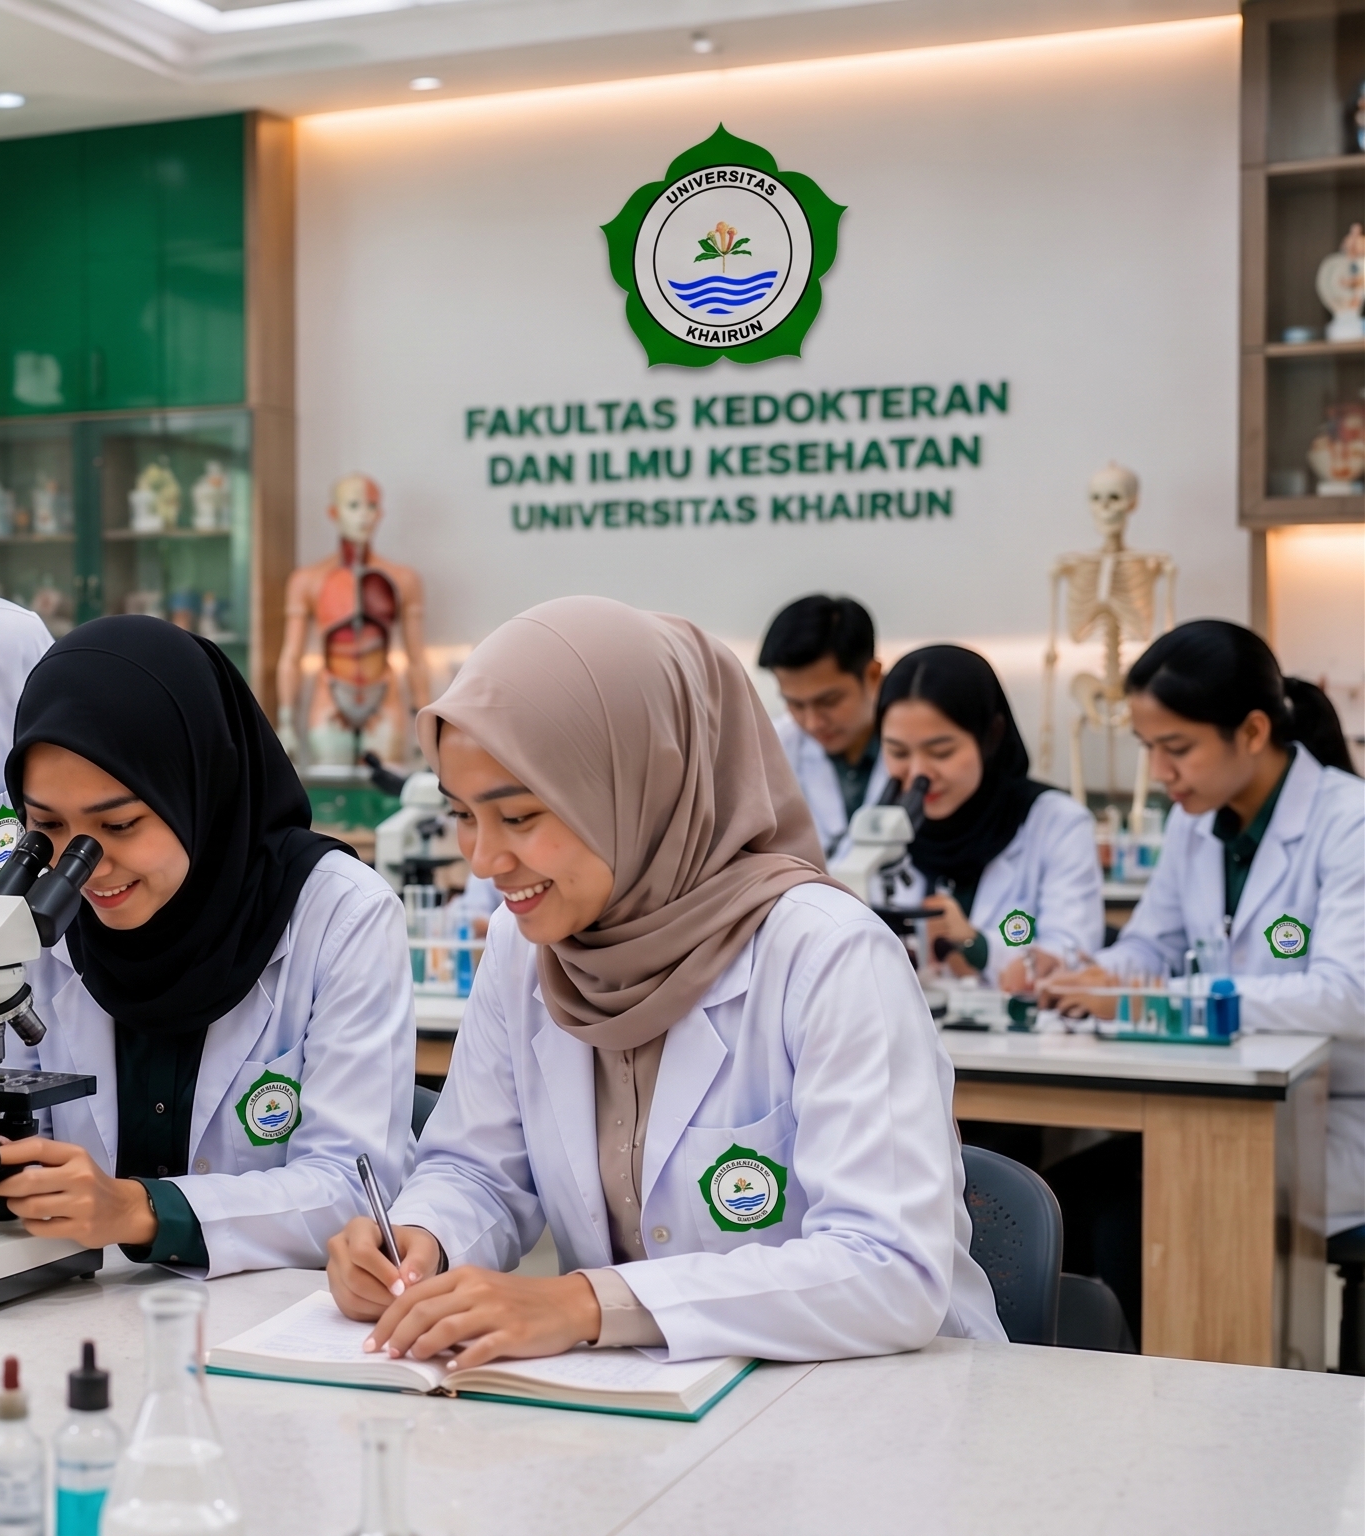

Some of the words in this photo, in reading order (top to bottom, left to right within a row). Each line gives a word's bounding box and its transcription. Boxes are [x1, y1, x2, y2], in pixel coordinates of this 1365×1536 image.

[665, 169, 777, 205] UNIVERSITAS
[685, 319, 764, 343] KHAIRUN
[465, 398, 677, 439] FAKULTAS
[692, 380, 1010, 428] KEDOKTERAN
[488, 453, 575, 487] DAN
[589, 447, 693, 483] ILMU
[708, 434, 982, 477] KESEHATAN
[511, 495, 758, 532] UNIVERSITAS
[770, 489, 954, 524] KHAIRUN
